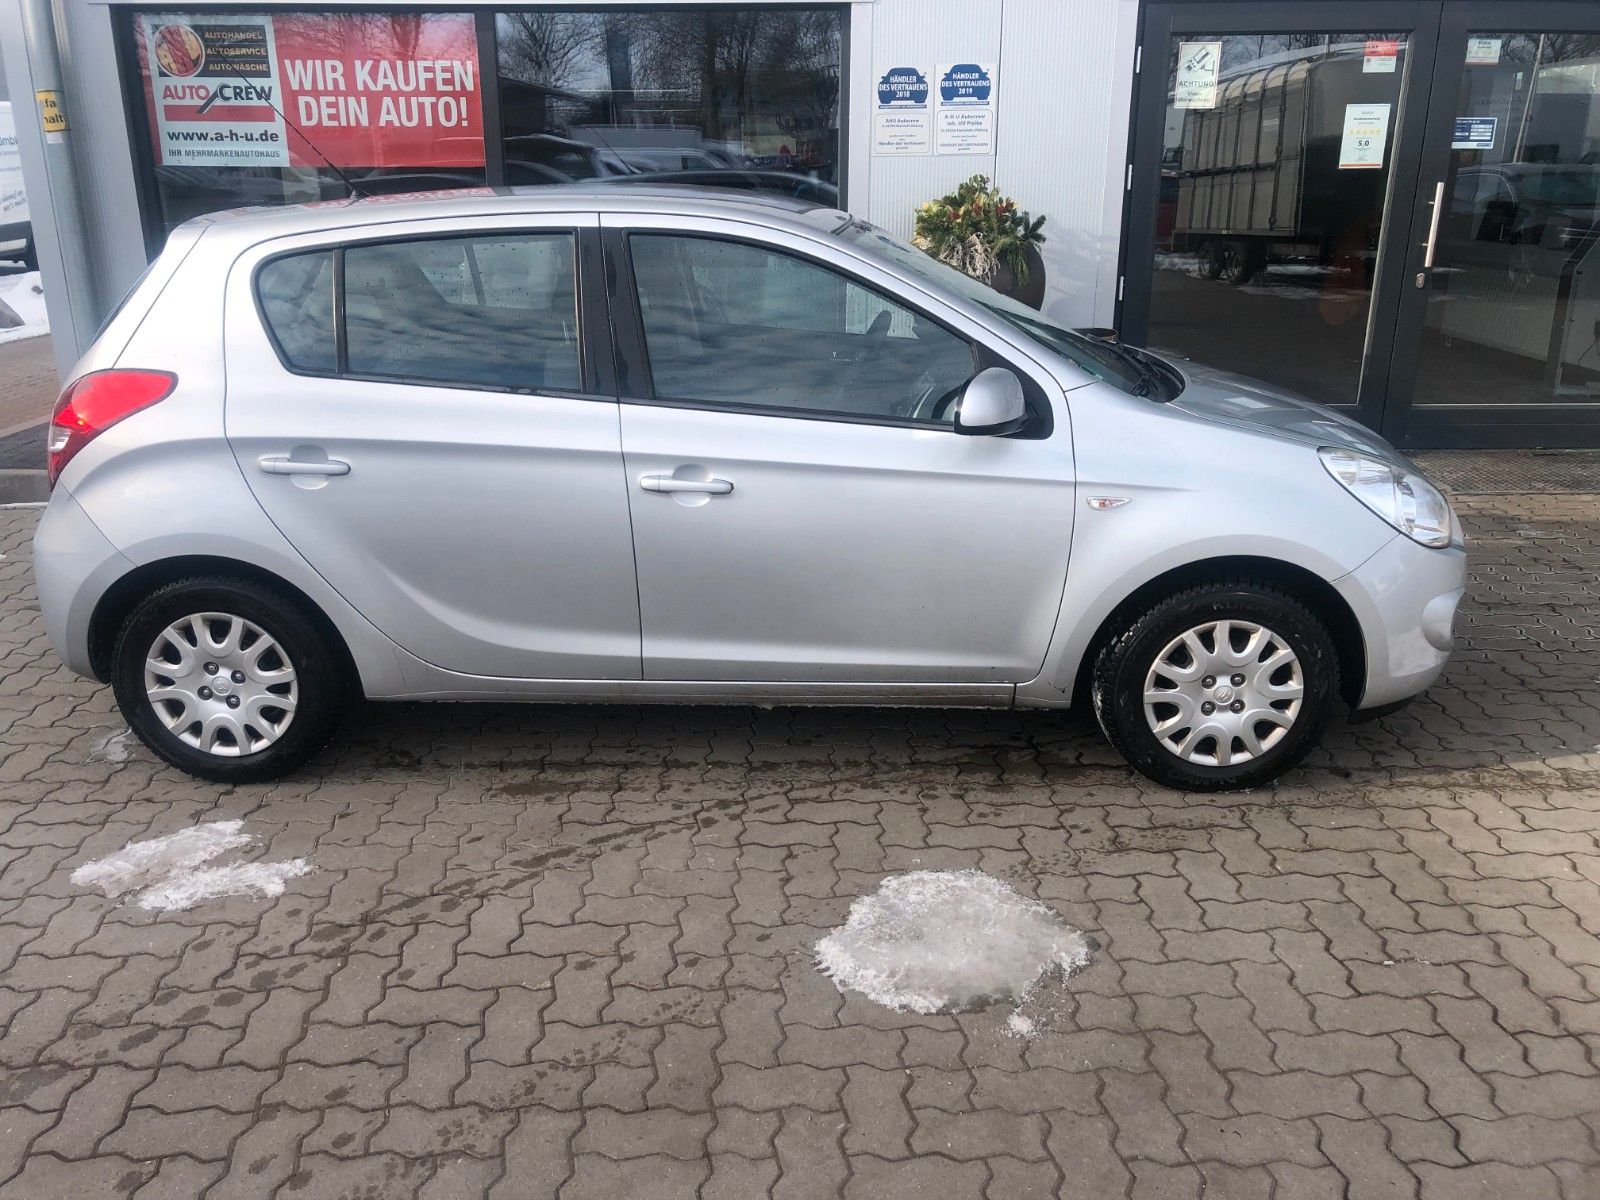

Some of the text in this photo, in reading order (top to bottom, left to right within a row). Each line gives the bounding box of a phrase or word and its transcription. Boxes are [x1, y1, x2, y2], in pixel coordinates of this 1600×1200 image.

[204, 31, 263, 40] AUTOHANDEL
[206, 47, 267, 56] AUTOSERVICE
[284, 59, 475, 92] WIR KAUFEN
[889, 75, 917, 83] HÄNDLER
[952, 72, 980, 80] HÄNDLER
[879, 83, 928, 91] DES VERTRAUENS
[297, 95, 468, 127] DEIN AUTO!
[167, 129, 279, 142] www.a-h-u.de
[1357, 140, 1370, 148] 5,0
[168, 149, 280, 158] IHR MEHRMARKENAUTOHAUS
